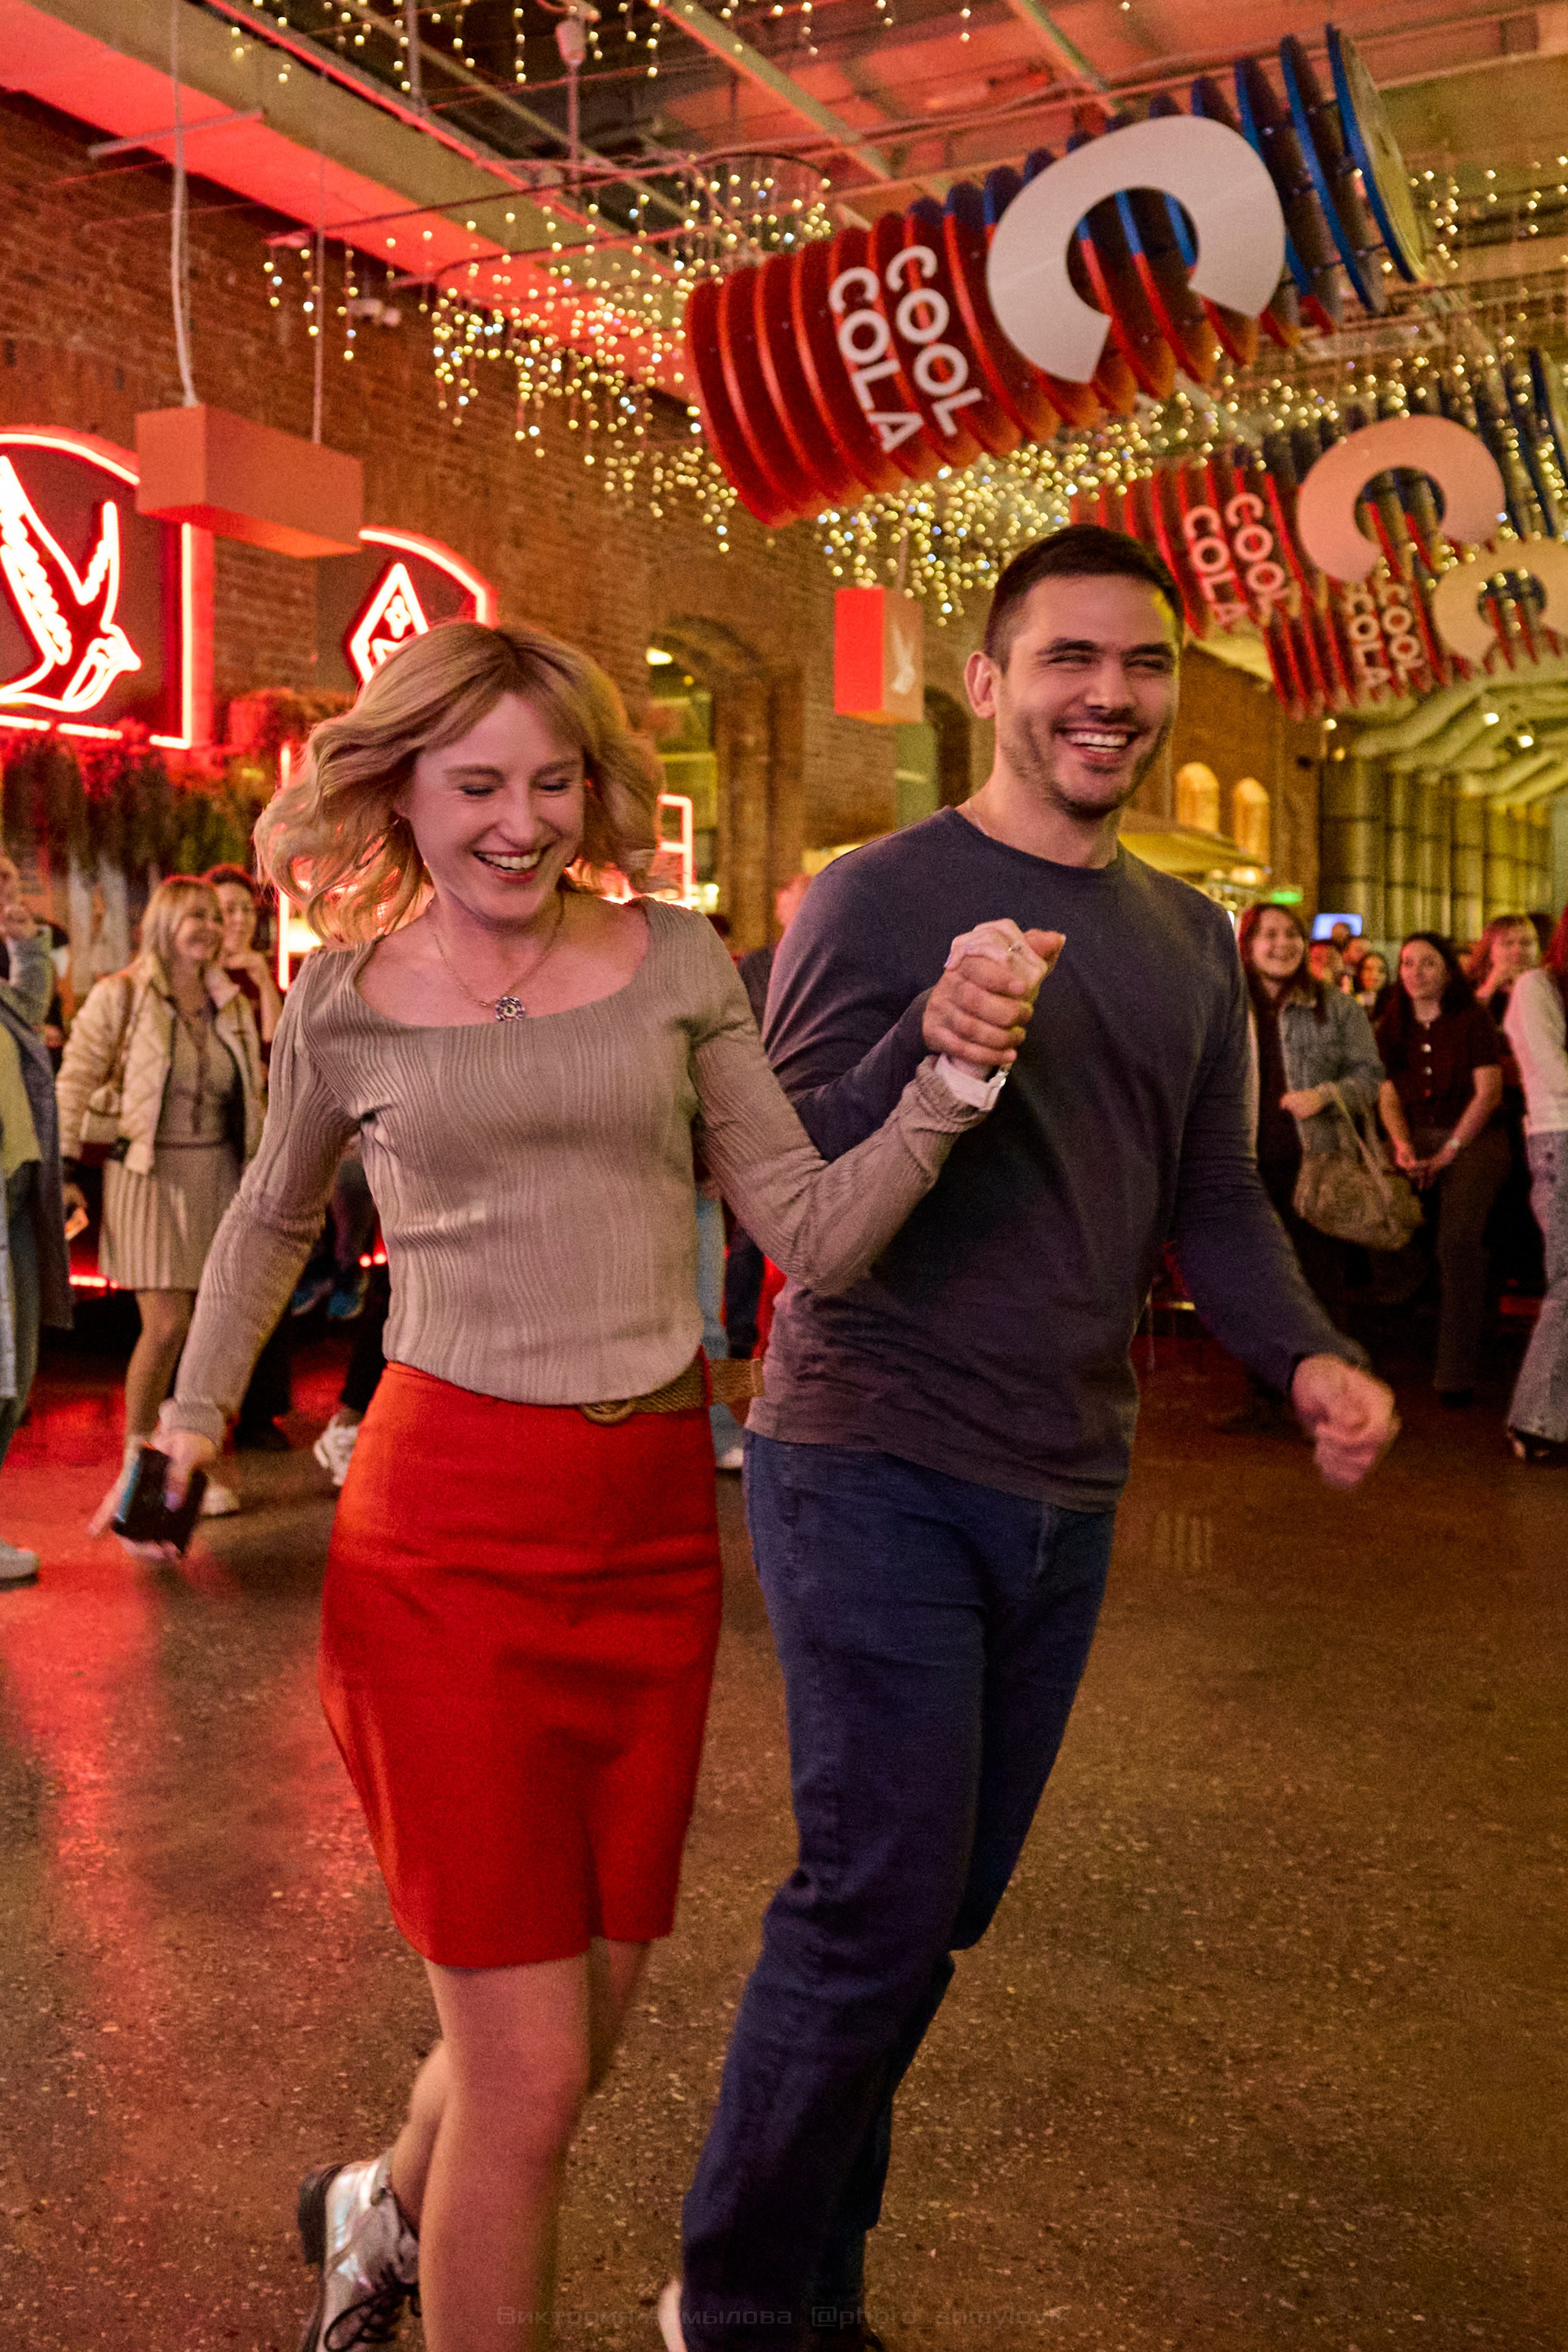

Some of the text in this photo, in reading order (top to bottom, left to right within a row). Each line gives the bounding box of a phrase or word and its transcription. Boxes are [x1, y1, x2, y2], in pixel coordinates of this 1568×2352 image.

[829, 267, 923, 452] COLA
[887, 245, 981, 435] COOL
[1184, 505, 1250, 624] COLA
